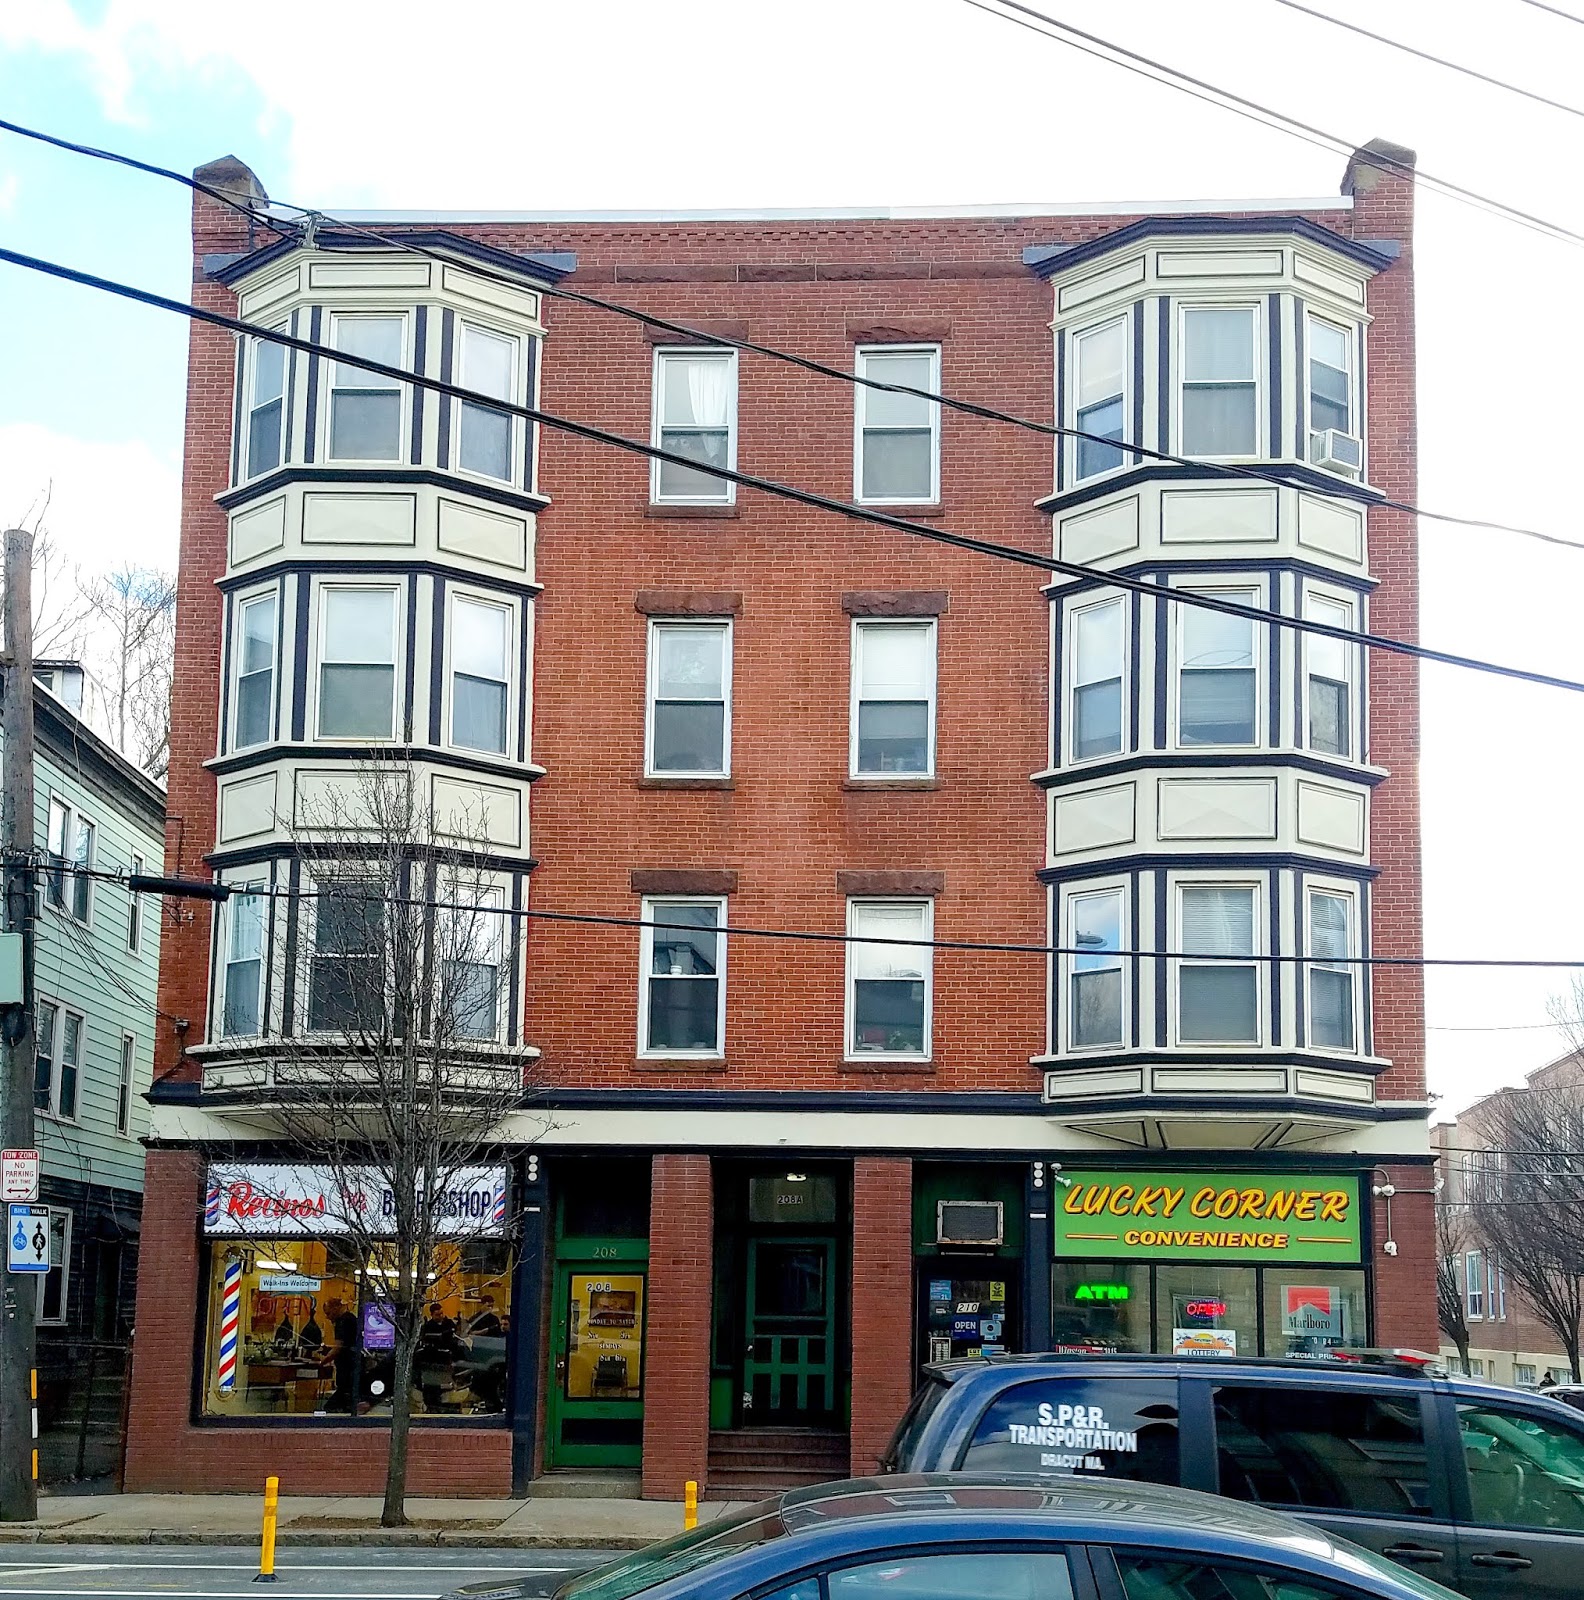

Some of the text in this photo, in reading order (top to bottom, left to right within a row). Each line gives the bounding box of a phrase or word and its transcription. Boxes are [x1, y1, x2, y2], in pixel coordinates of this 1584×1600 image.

[777, 1195, 803, 1204] 208A
[1064, 1184, 1349, 1222] LUCKY CORNER
[1124, 1231, 1289, 1248] CONVENIENCE
[592, 1247, 617, 1258] 208
[587, 1283, 611, 1292] 208
[1075, 1285, 1128, 1299] ATM
[957, 1303, 979, 1312] 210
[1187, 1302, 1227, 1315] OPEN
[954, 1321, 976, 1330] OPEN
[1288, 1314, 1330, 1329] Marlboro
[1038, 1402, 1109, 1430] S.P&R.
[1008, 1424, 1137, 1452] TRANSPORTATION
[1040, 1453, 1084, 1469] DRACUT
